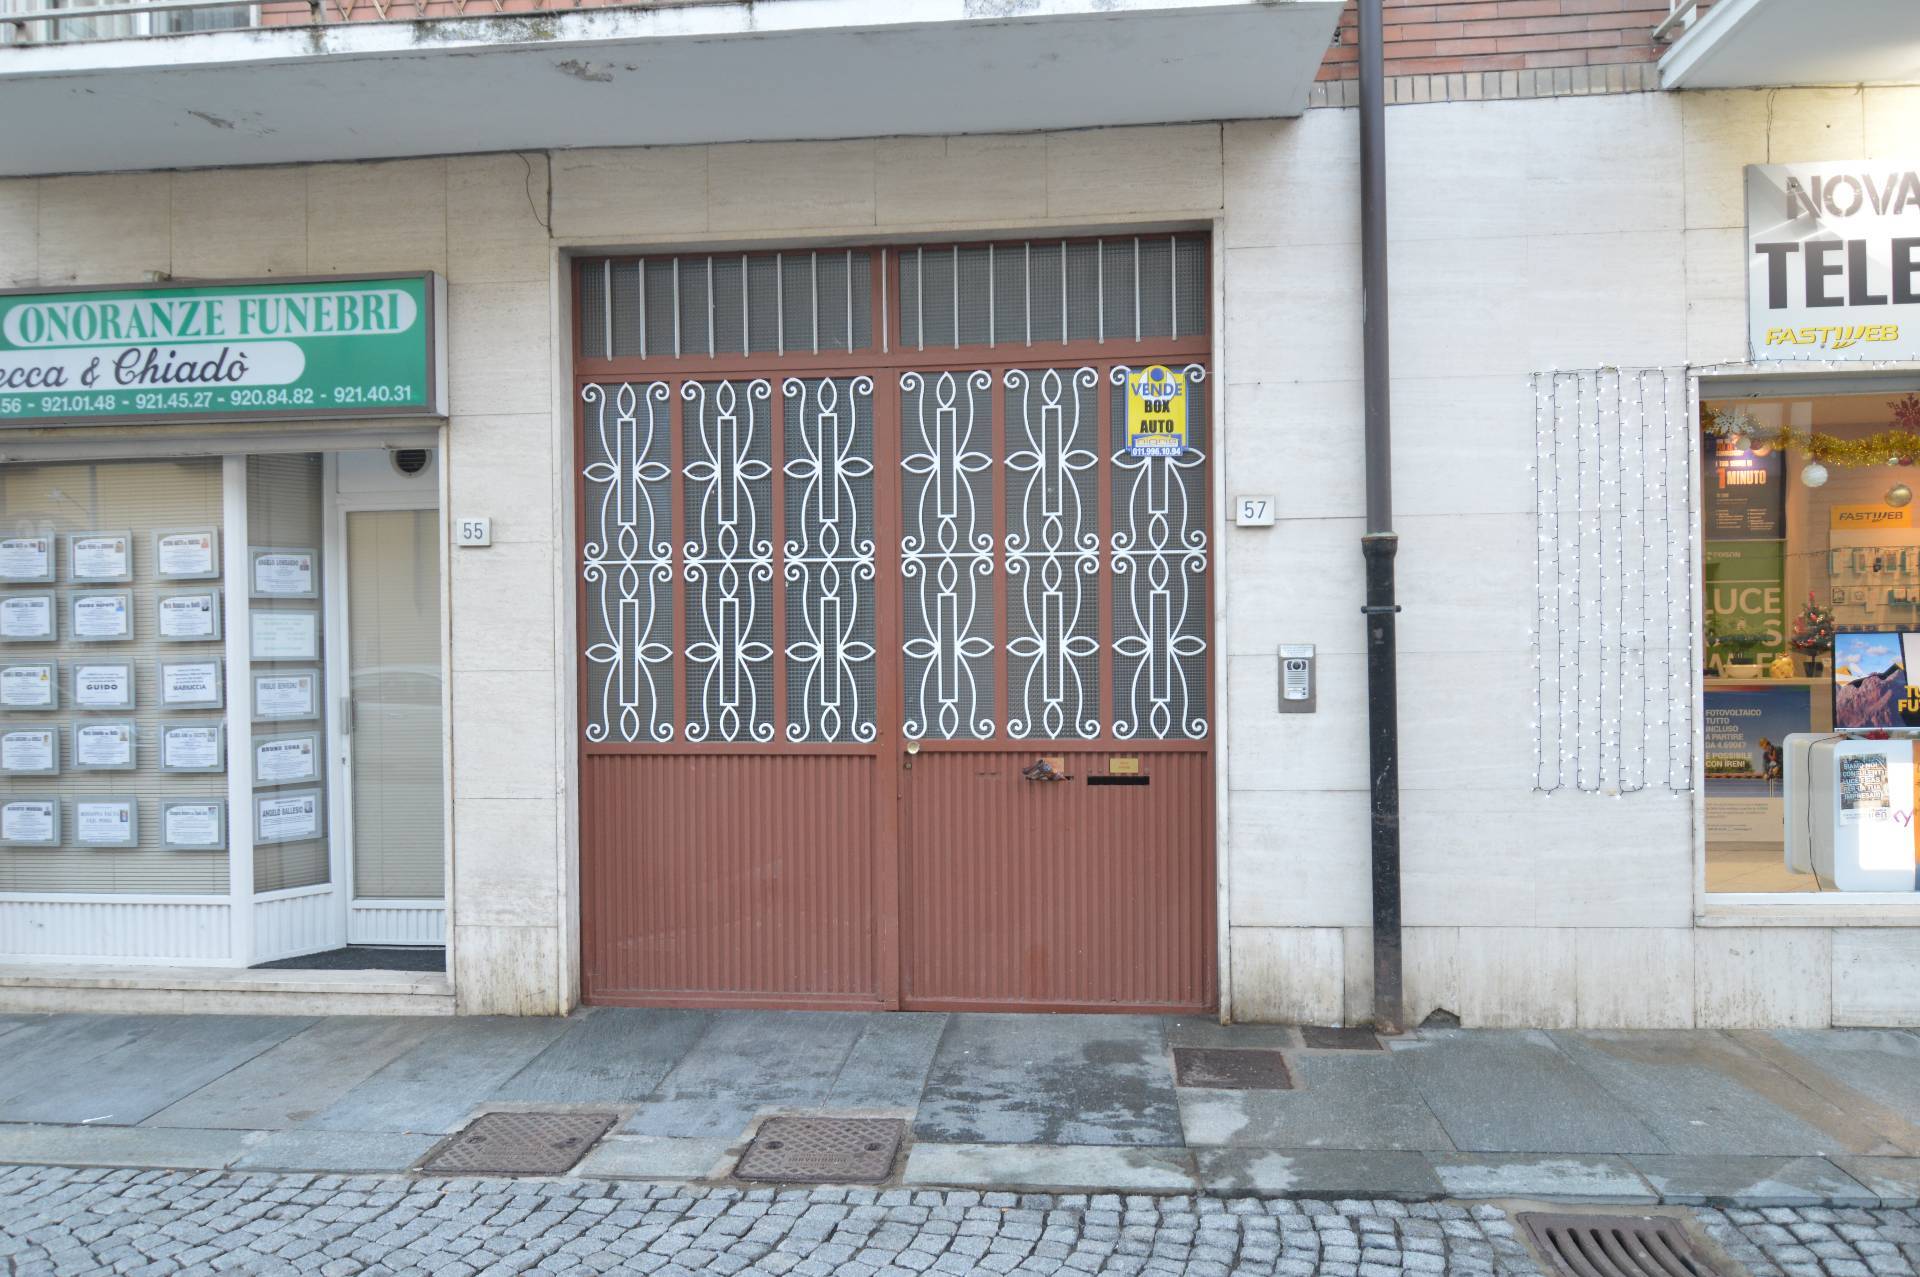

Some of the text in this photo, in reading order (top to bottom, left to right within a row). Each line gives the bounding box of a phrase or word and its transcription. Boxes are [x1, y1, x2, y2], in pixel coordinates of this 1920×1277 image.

[19, 293, 402, 343] ONORANZE FUNEBRI
[1765, 325, 1899, 349] FASTWEB
[80, 356, 100, 388] &
[112, 346, 249, 386] Chiadò
[1131, 382, 1183, 396] VENDE
[41, 395, 116, 412] 921.01.48
[135, 391, 213, 409] 921.45.27
[230, 388, 313, 406] 920.84.82
[334, 385, 412, 403] 921.40.31
[1144, 400, 1171, 413] BOX
[1139, 419, 1175, 434] AUTO
[1717, 467, 1767, 489] 1 MINUTO
[1244, 501, 1267, 519] 57
[1838, 510, 1904, 523] FASTWEB
[463, 522, 483, 540] 55
[86, 683, 118, 691] GUIDO
[1705, 708, 1762, 717] FOTOVOLTAICO
[1705, 717, 1730, 725] TUTTO
[1705, 725, 1739, 733] INCLUSO
[1705, 760, 1723, 768] CON
